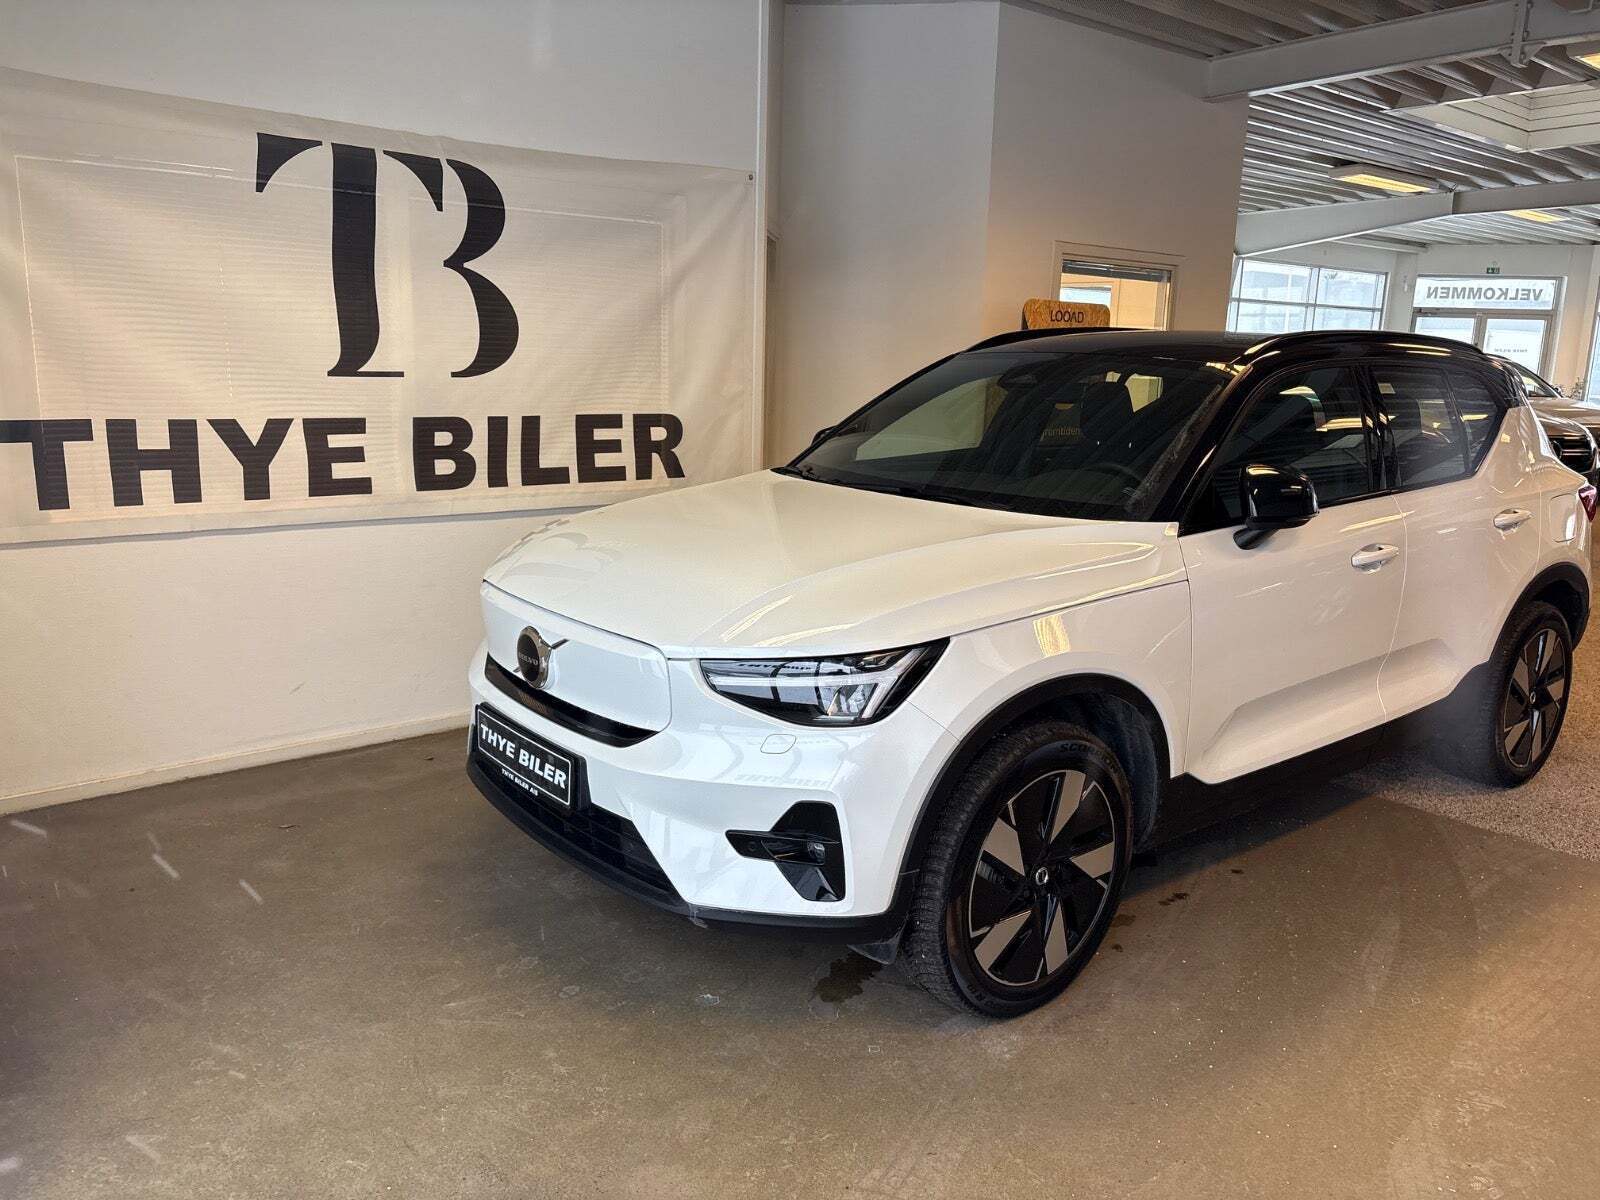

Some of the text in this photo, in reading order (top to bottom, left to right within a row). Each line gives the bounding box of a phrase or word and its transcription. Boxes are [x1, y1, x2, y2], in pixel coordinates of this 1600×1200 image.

[0, 413, 686, 510] THYE BILER
[480, 724, 567, 789] THYE BILER
[514, 775, 529, 790] BILER
